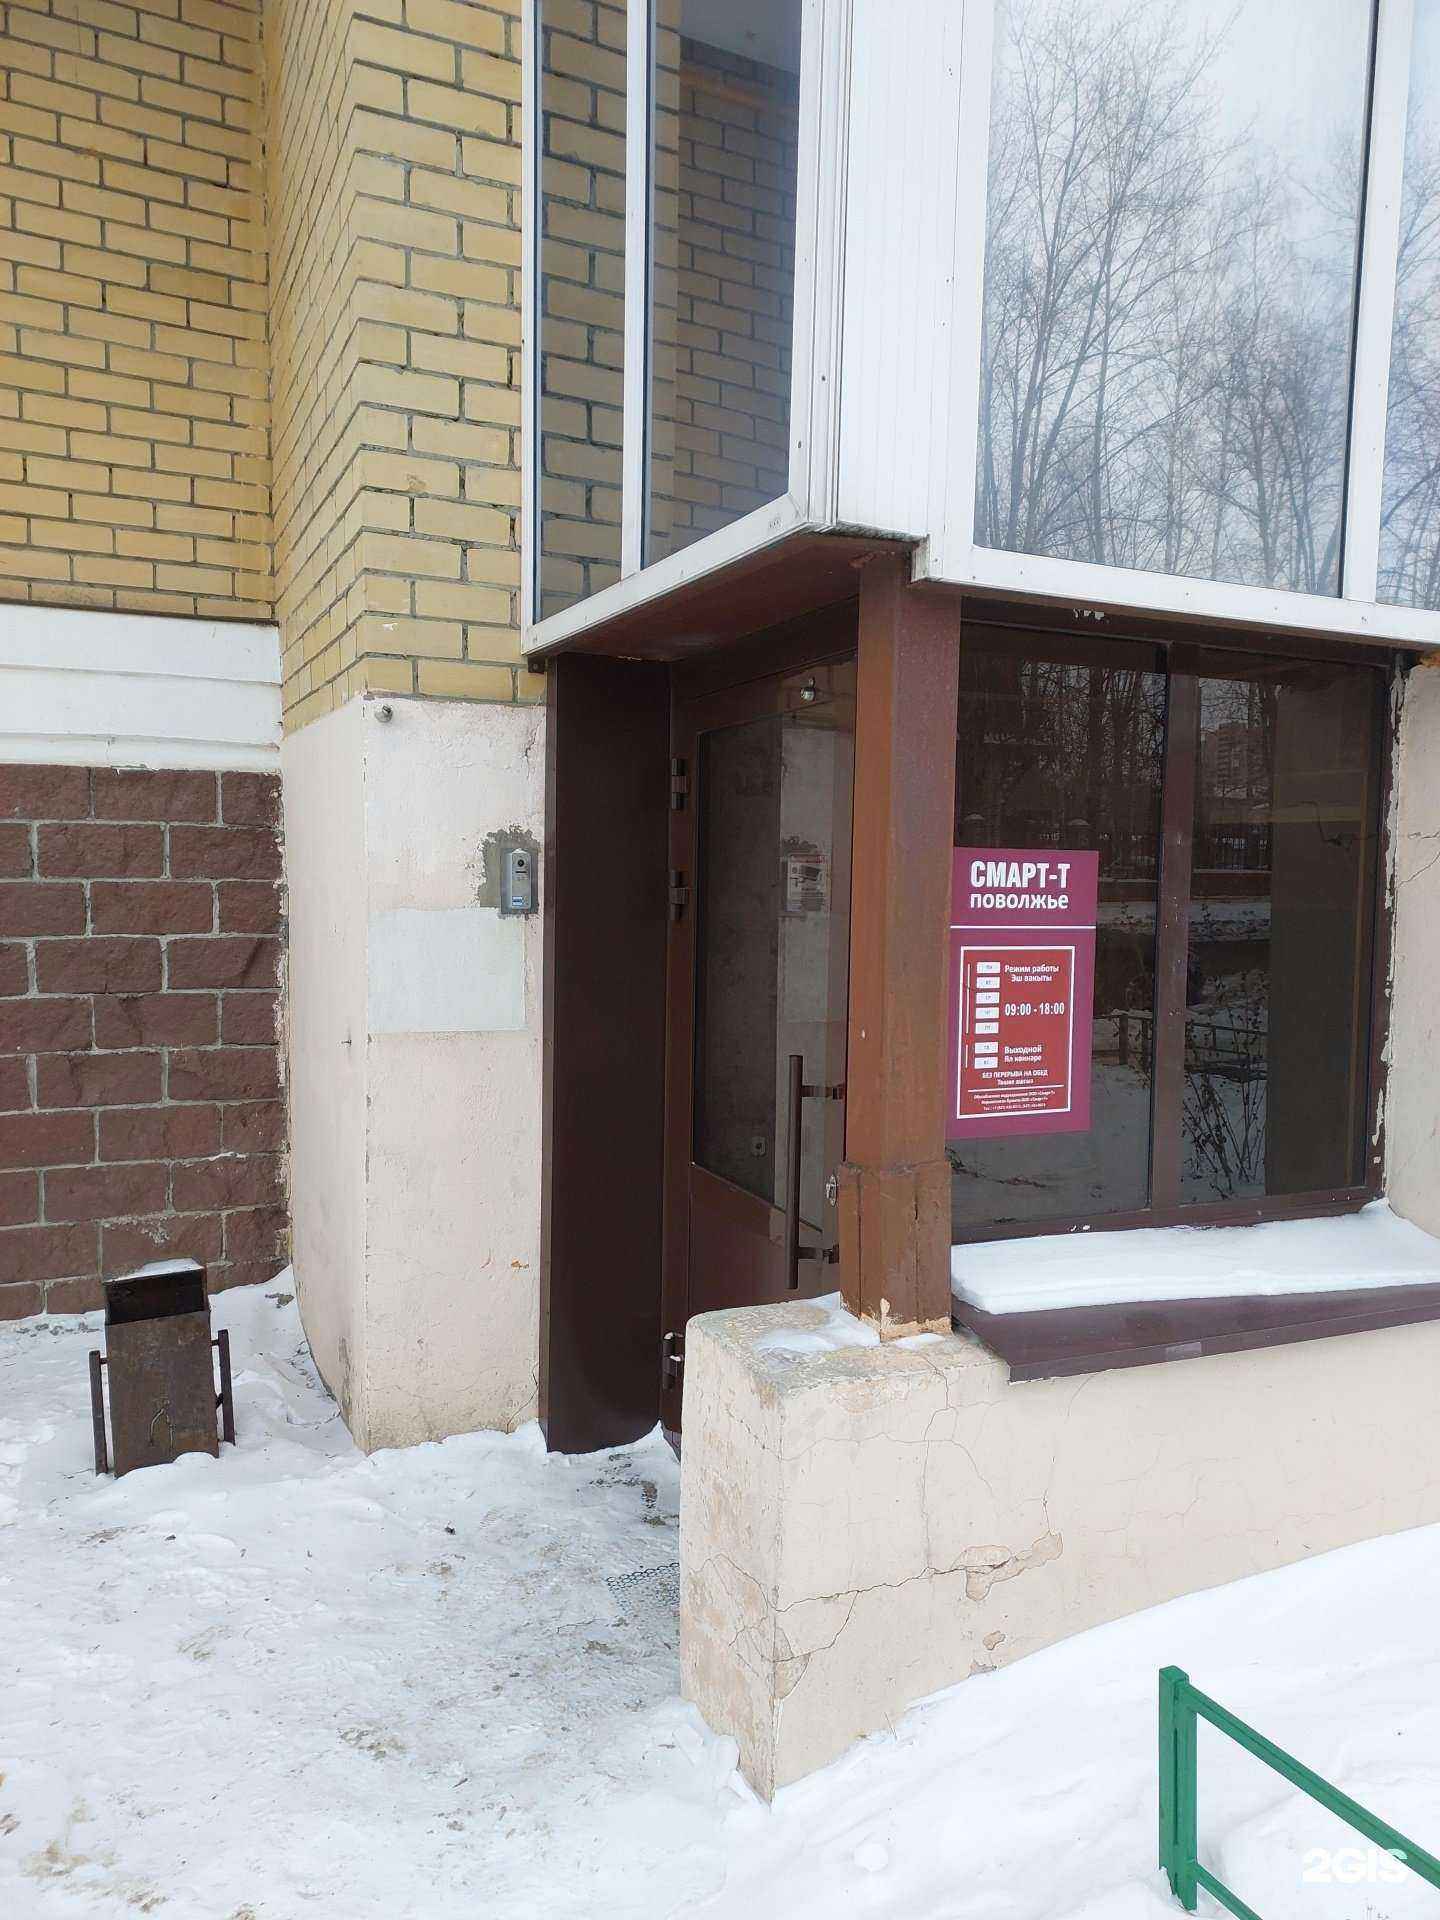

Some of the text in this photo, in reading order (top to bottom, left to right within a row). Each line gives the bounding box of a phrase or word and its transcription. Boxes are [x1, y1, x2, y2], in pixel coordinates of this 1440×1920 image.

[970, 860, 1071, 889] СМАРТ-Т
[970, 892, 1069, 910] поволжье
[1004, 964, 1031, 973] Режим
[1032, 963, 1060, 974] работы
[1004, 1003, 1032, 1016] 09:00
[1039, 1002, 1065, 1015] 18:00
[1004, 1044, 1042, 1055] Выходной
